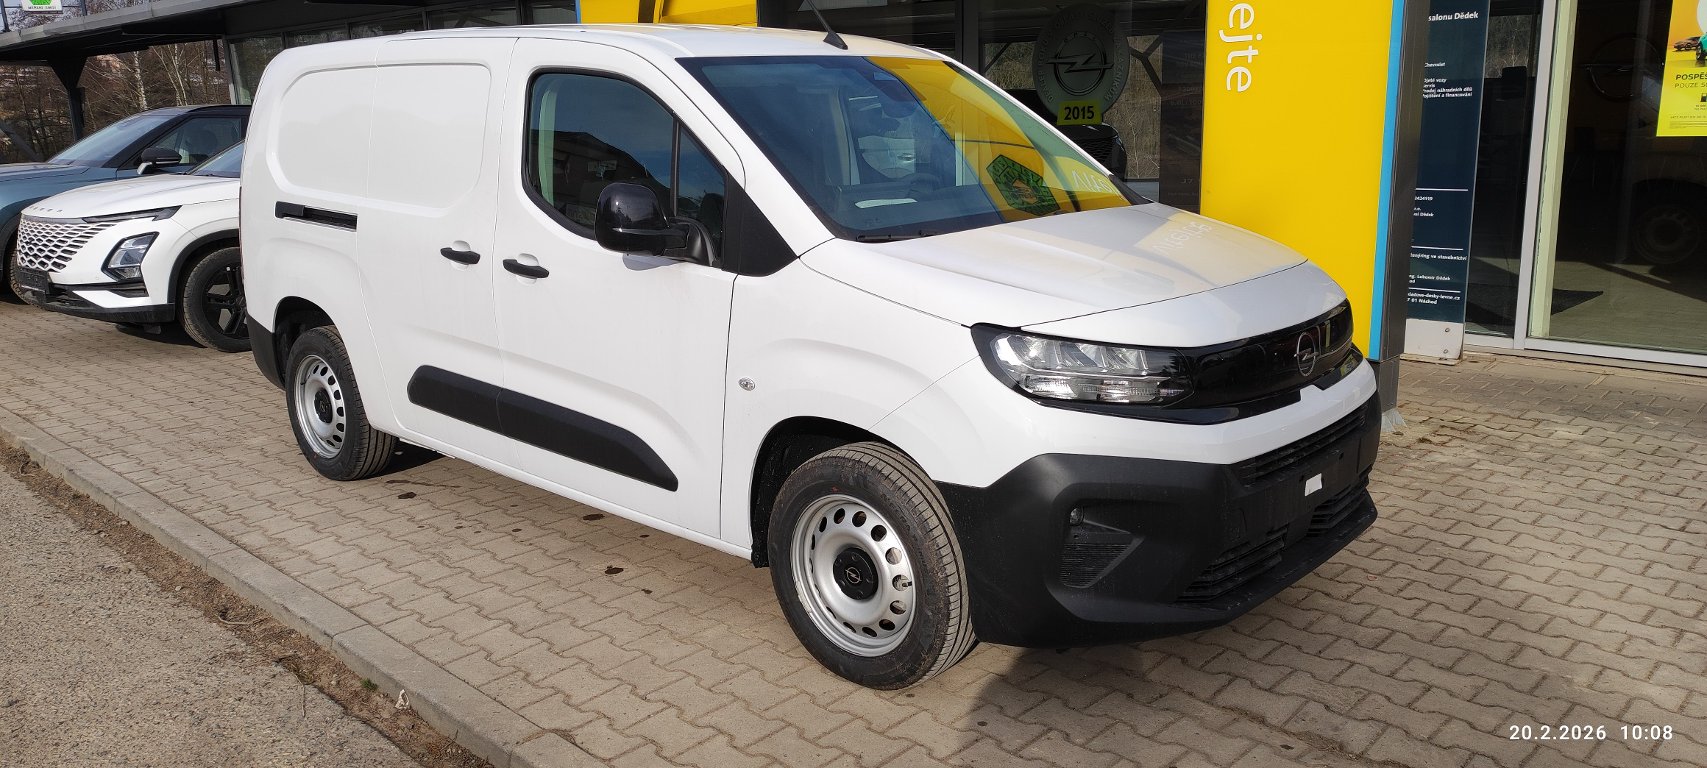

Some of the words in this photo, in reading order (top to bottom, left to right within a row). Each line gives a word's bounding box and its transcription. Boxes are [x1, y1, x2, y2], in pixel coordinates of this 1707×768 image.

[1454, 11, 1479, 20] Dědek
[1219, 0, 1263, 92] ejte
[1064, 105, 1095, 121] 2015
